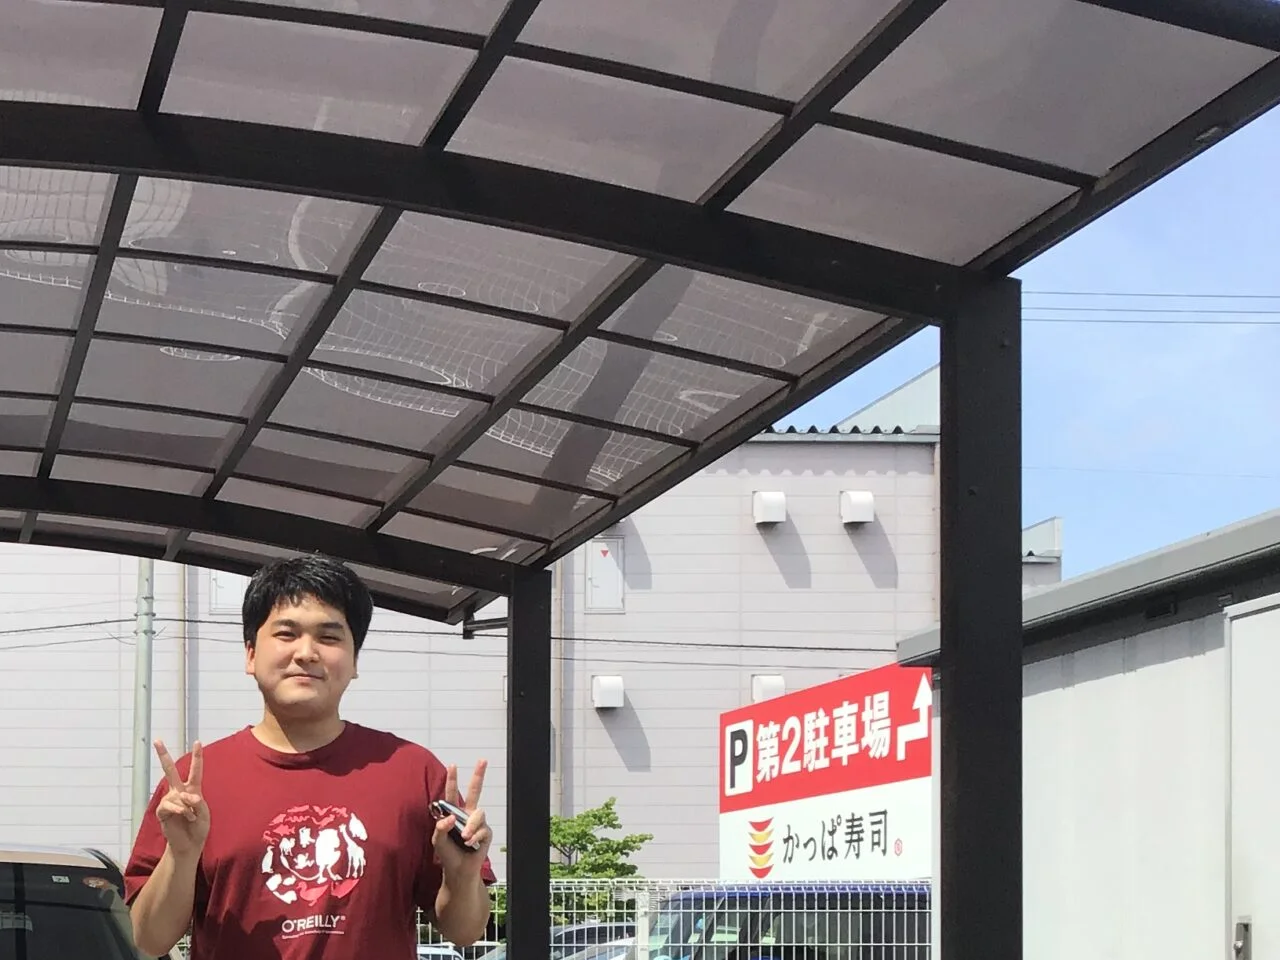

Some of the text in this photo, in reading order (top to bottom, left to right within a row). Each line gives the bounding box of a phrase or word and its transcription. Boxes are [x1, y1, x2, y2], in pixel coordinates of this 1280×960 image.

[729, 691, 891, 789] P 第2駐車場
[783, 809, 888, 863] かっぱ寿司
